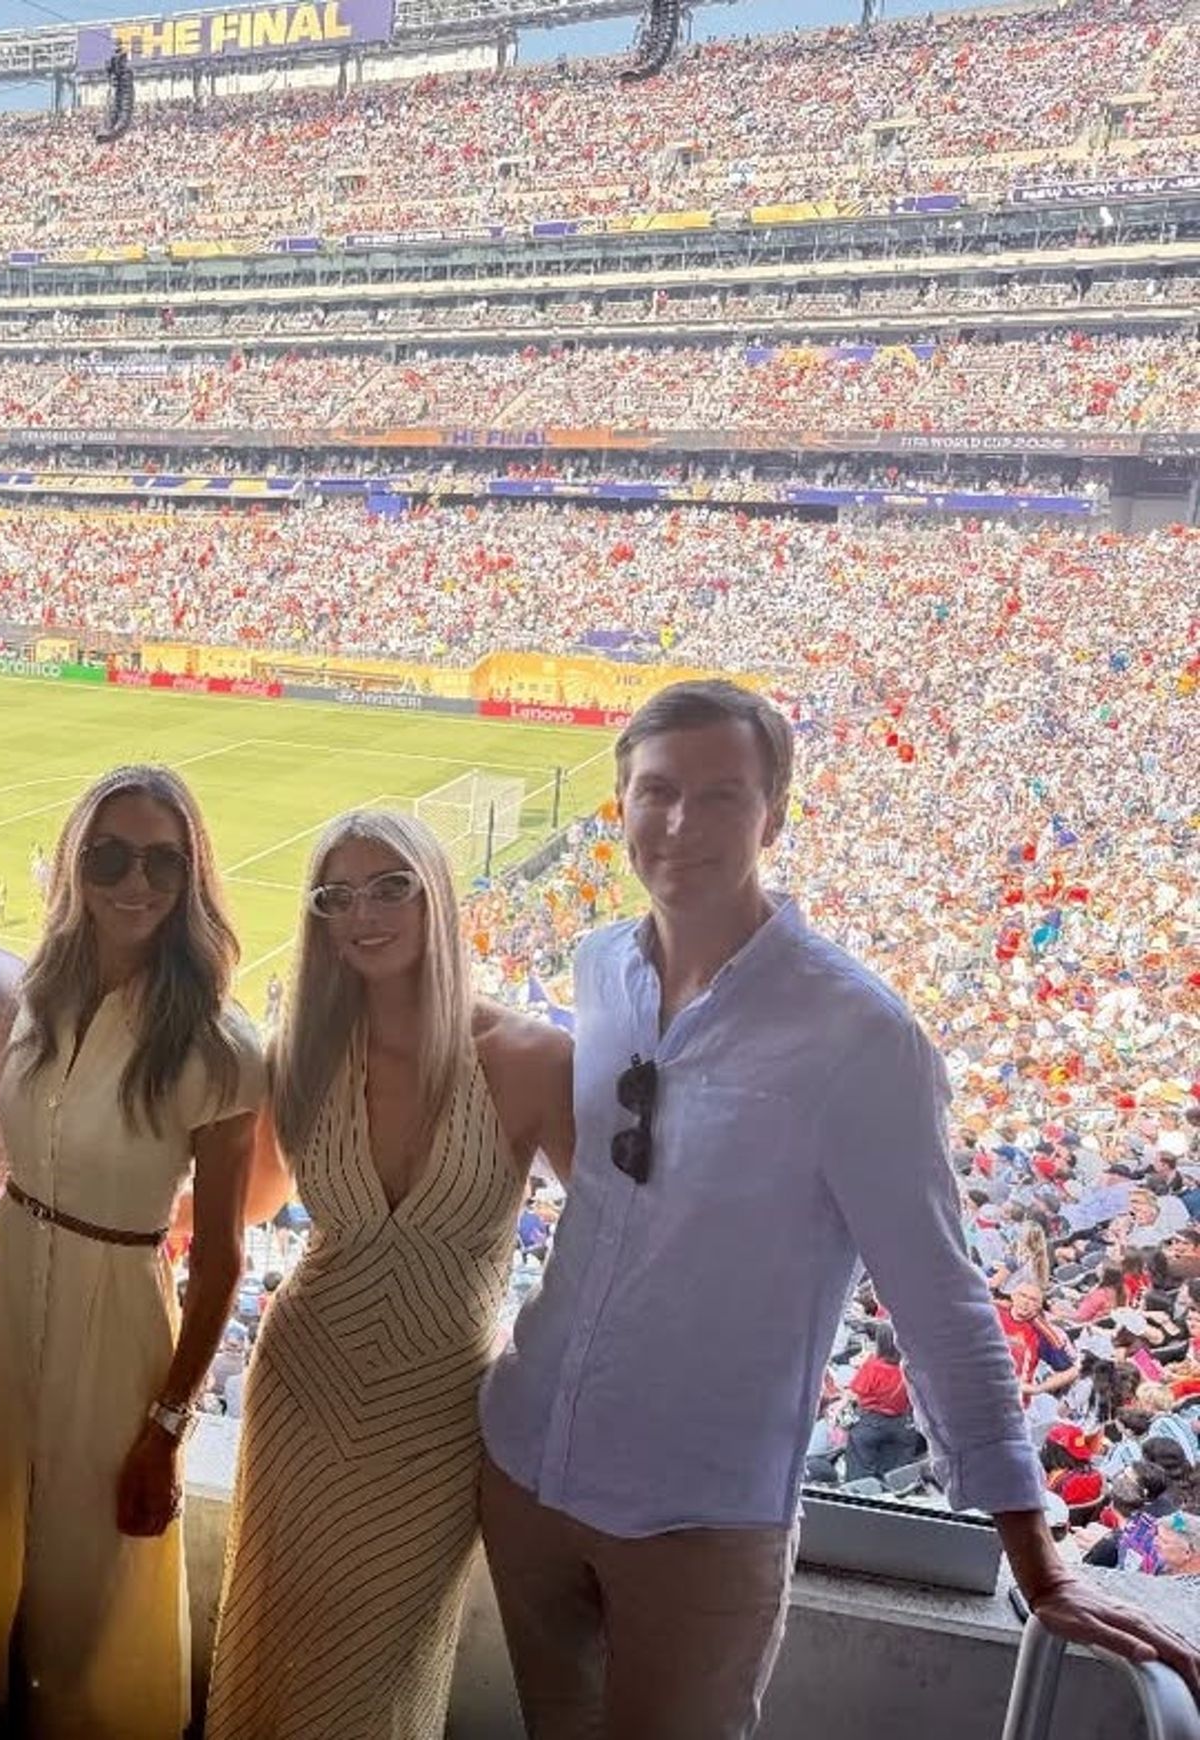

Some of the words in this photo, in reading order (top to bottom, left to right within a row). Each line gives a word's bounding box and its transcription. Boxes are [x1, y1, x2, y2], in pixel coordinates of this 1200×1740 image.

[111, 20, 201, 60] THE
[210, 2, 350, 54] FINAL
[931, 437, 981, 449] WORLD
[984, 437, 1011, 449] CUP
[1013, 438, 1068, 449] 2026
[510, 704, 575, 722] Lenovo
